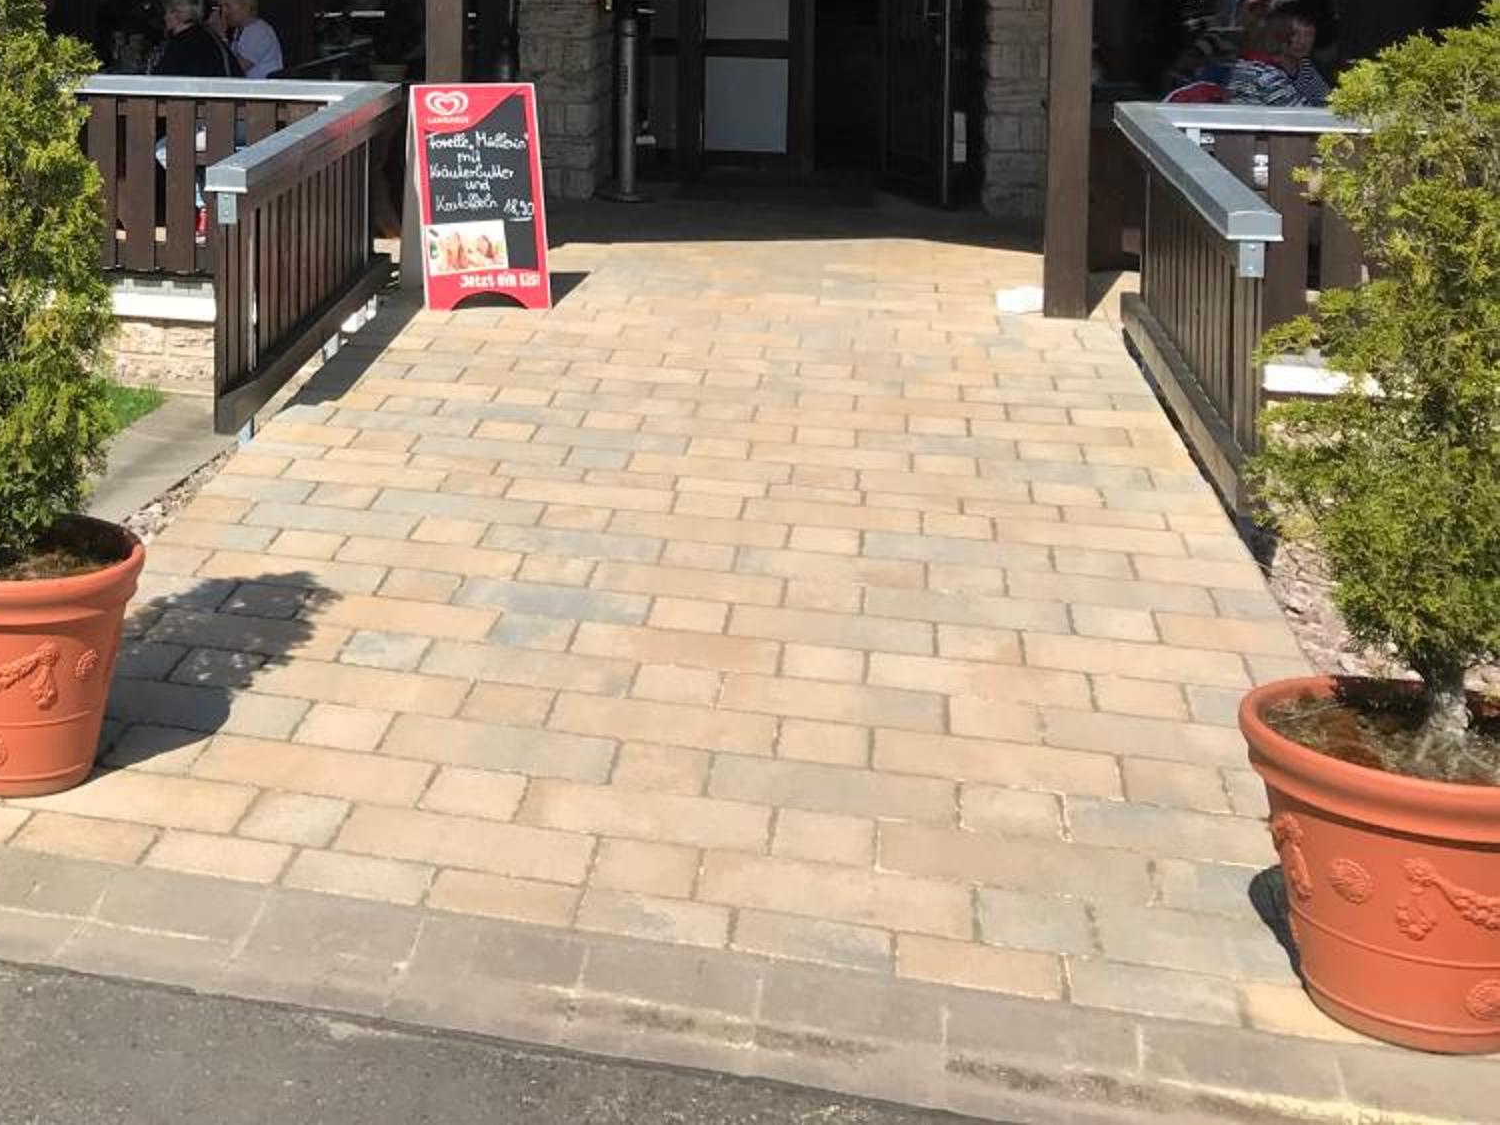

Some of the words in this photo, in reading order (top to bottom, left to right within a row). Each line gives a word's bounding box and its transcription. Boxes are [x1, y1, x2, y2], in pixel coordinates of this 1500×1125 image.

[425, 131, 469, 150] Forelle
[457, 149, 481, 164] mit
[429, 162, 515, 180] Kräuterbutter
[465, 178, 491, 191] und
[435, 192, 498, 212] Kartoffeln
[459, 273, 495, 289] Jetzt
[497, 270, 517, 288] ein
